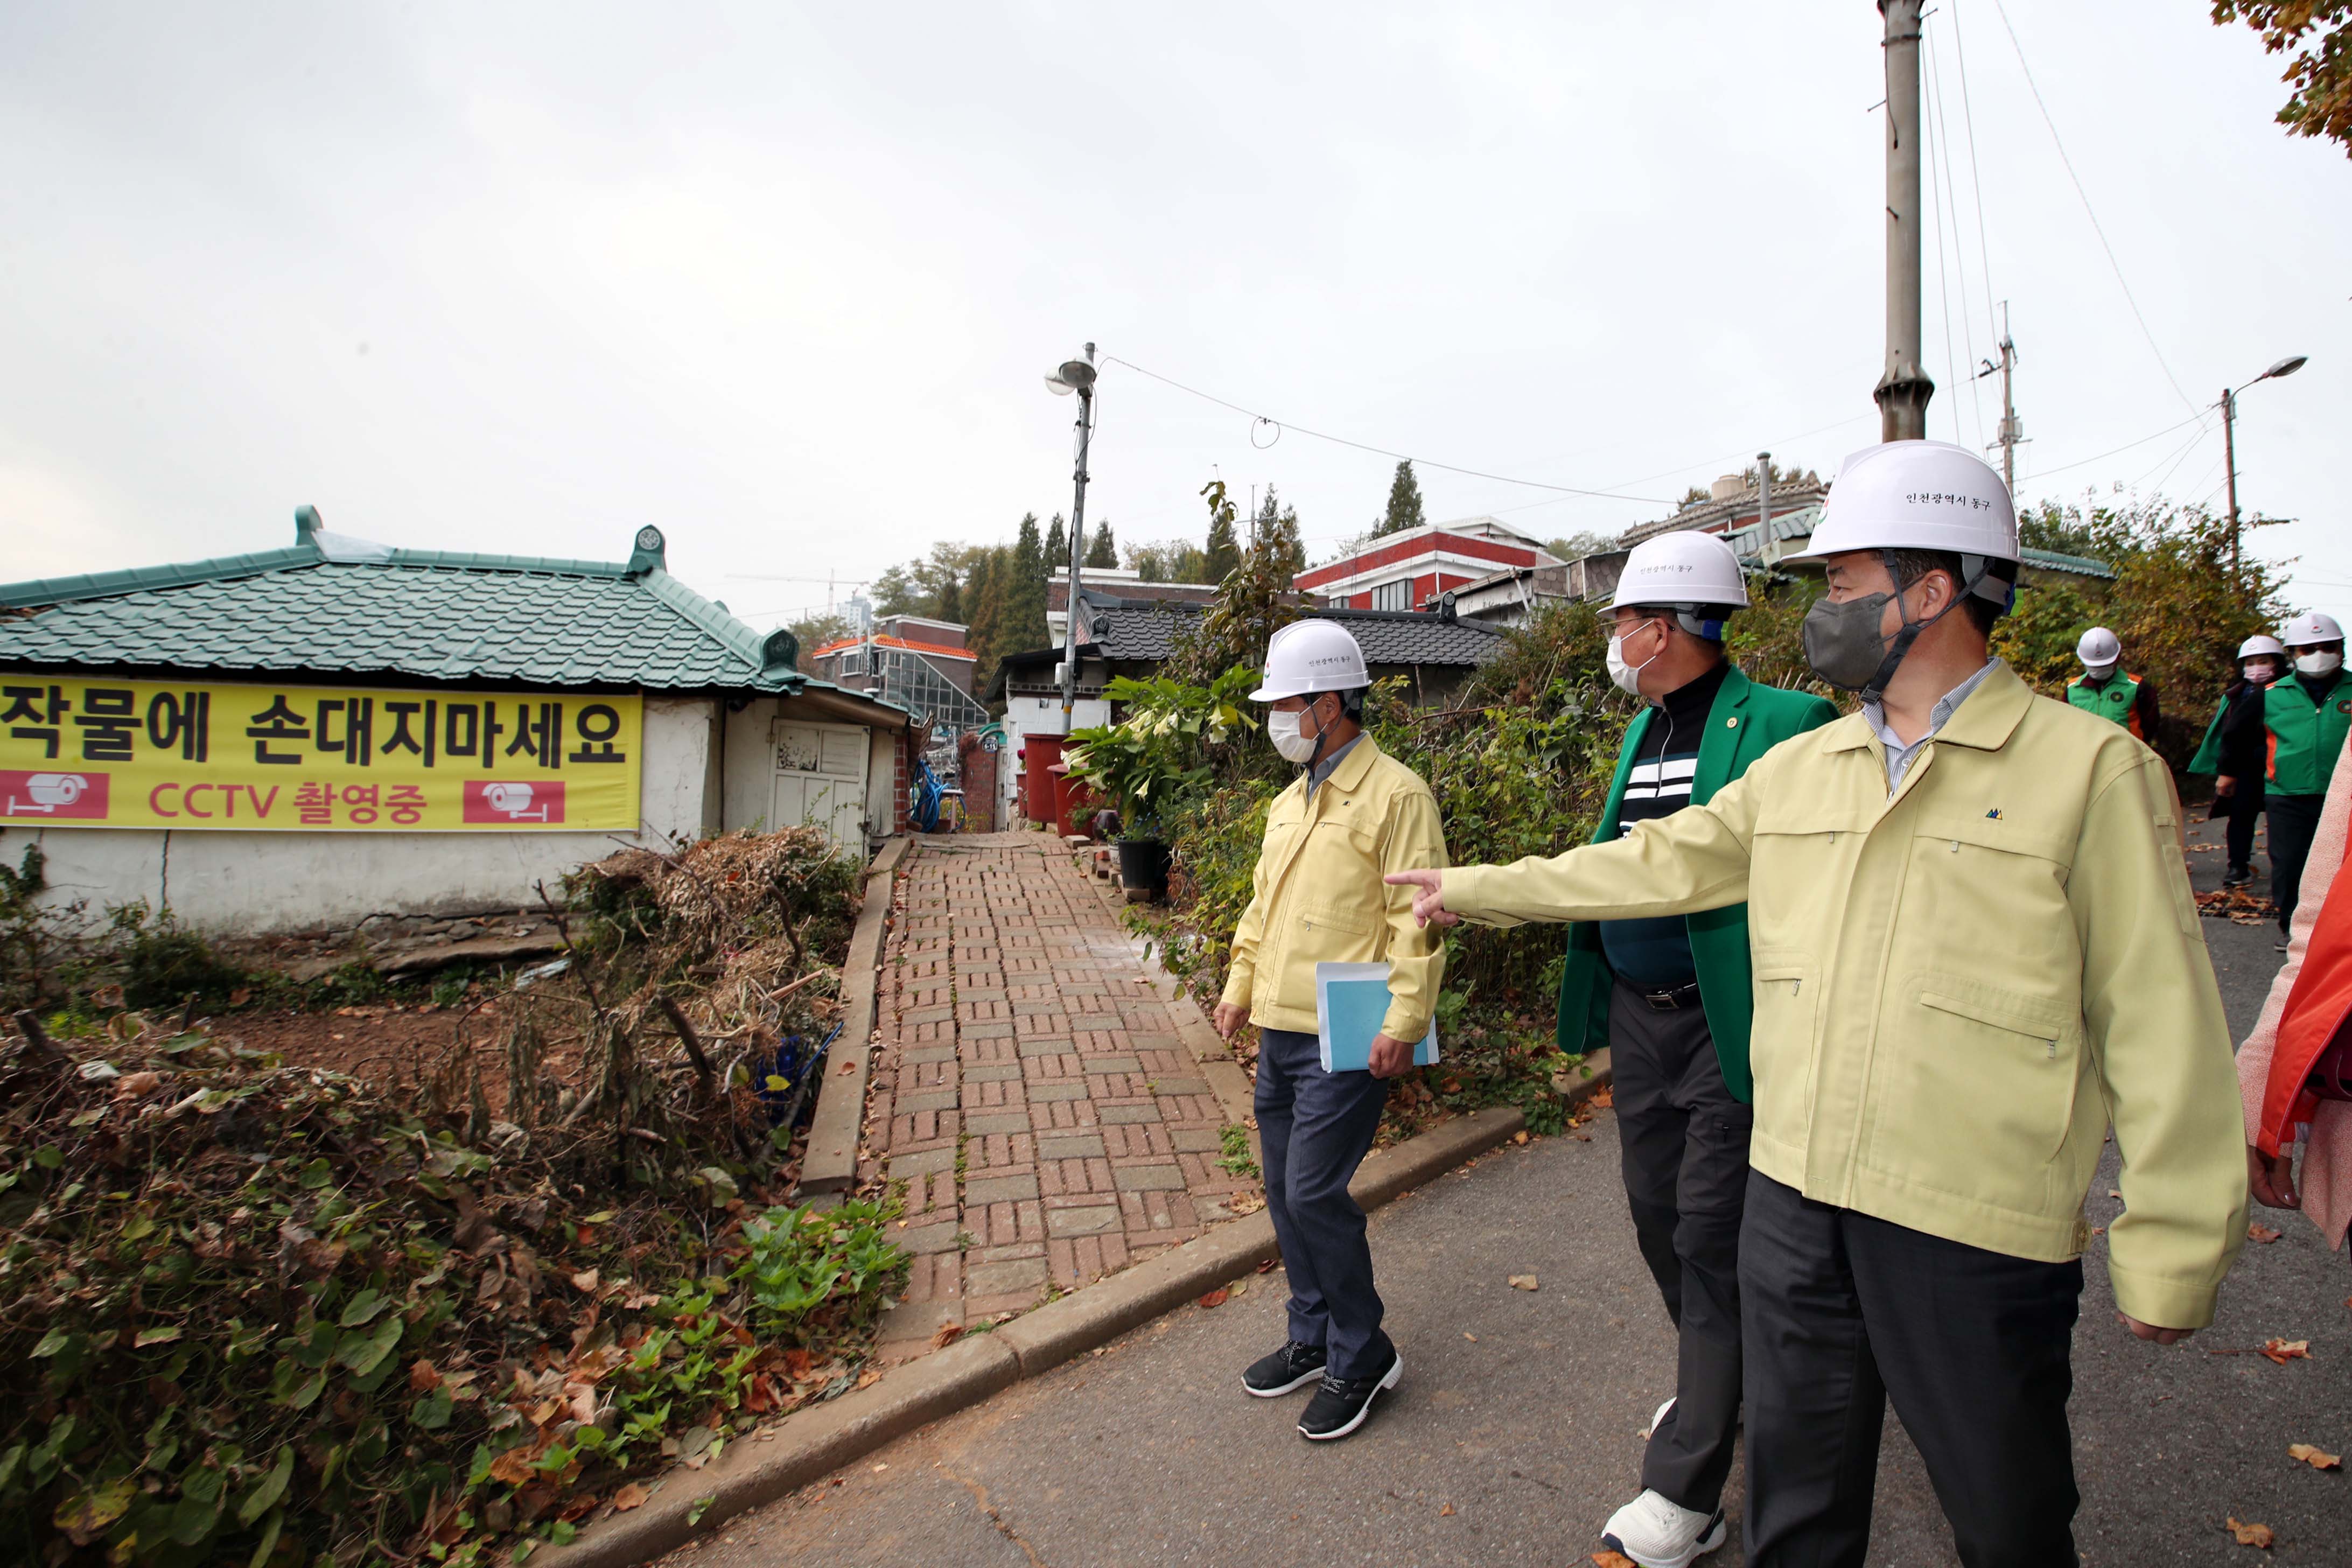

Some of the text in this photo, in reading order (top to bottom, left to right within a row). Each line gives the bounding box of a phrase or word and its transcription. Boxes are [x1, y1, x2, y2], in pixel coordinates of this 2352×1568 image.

[1906, 493, 1991, 511] 인천광역시 동구
[0, 685, 626, 769] 작물에 손대지마세요
[149, 782, 428, 824] CCTV 촬영중
